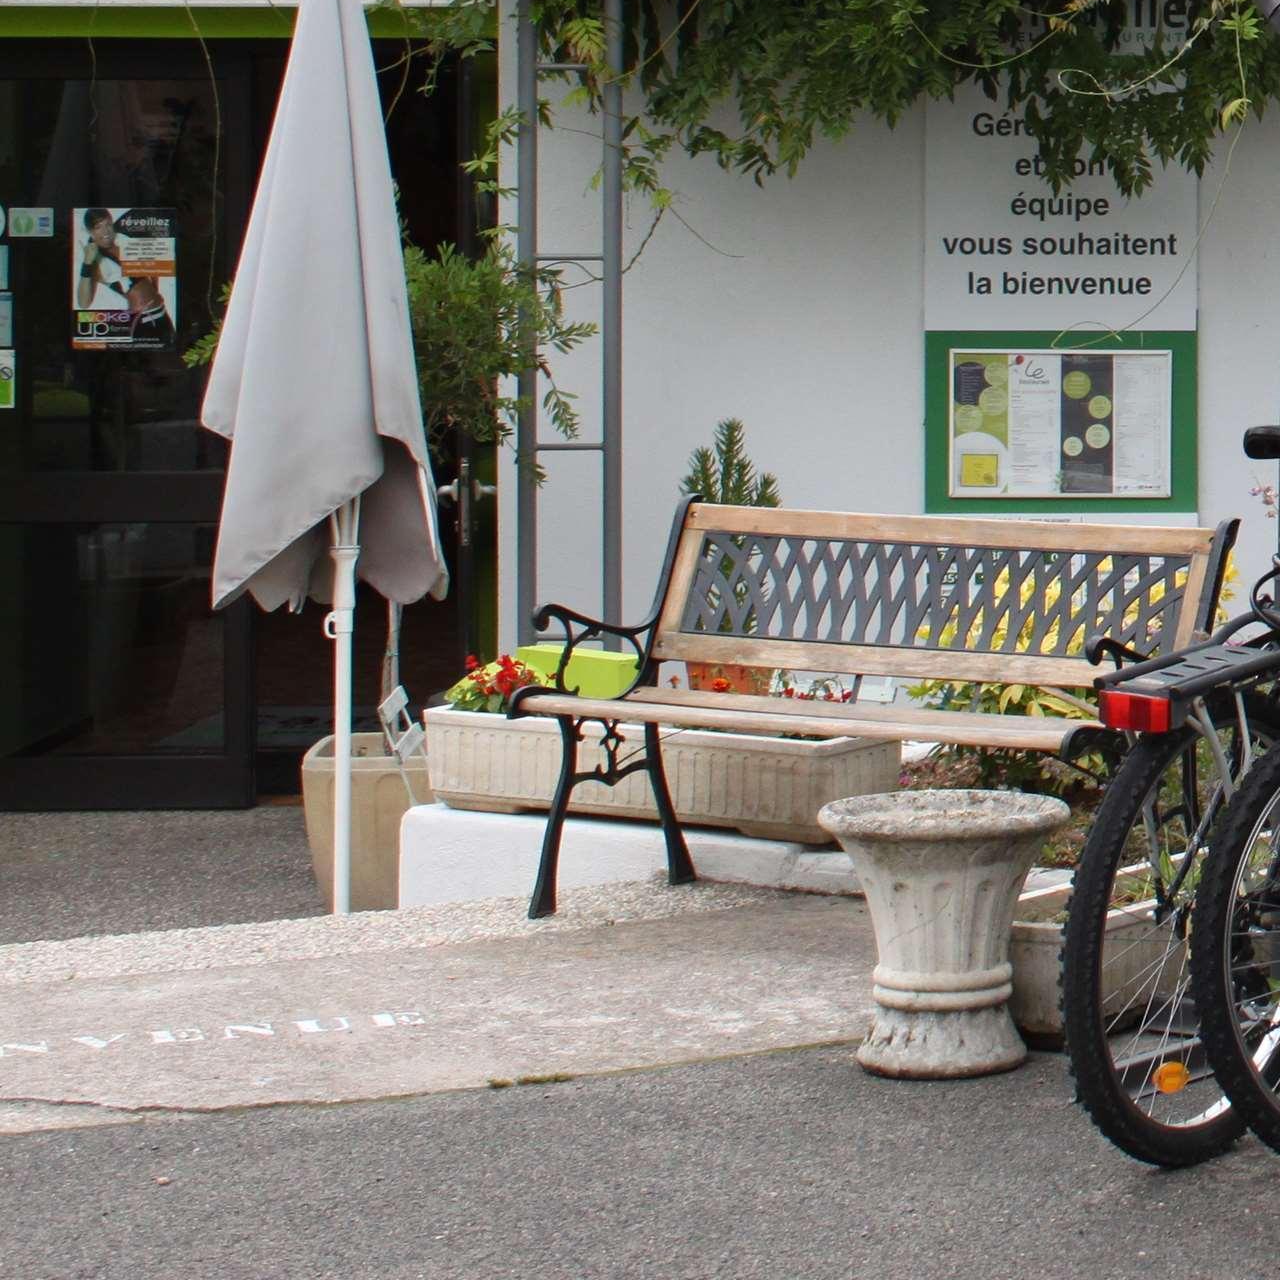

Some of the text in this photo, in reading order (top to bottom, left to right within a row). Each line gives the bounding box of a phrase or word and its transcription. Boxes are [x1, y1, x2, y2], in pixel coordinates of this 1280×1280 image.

[1015, 157, 1104, 177] et on
[1010, 191, 1110, 221] équipe
[943, 232, 1178, 256] vous souhaitent
[967, 271, 1153, 296] la bienvenue
